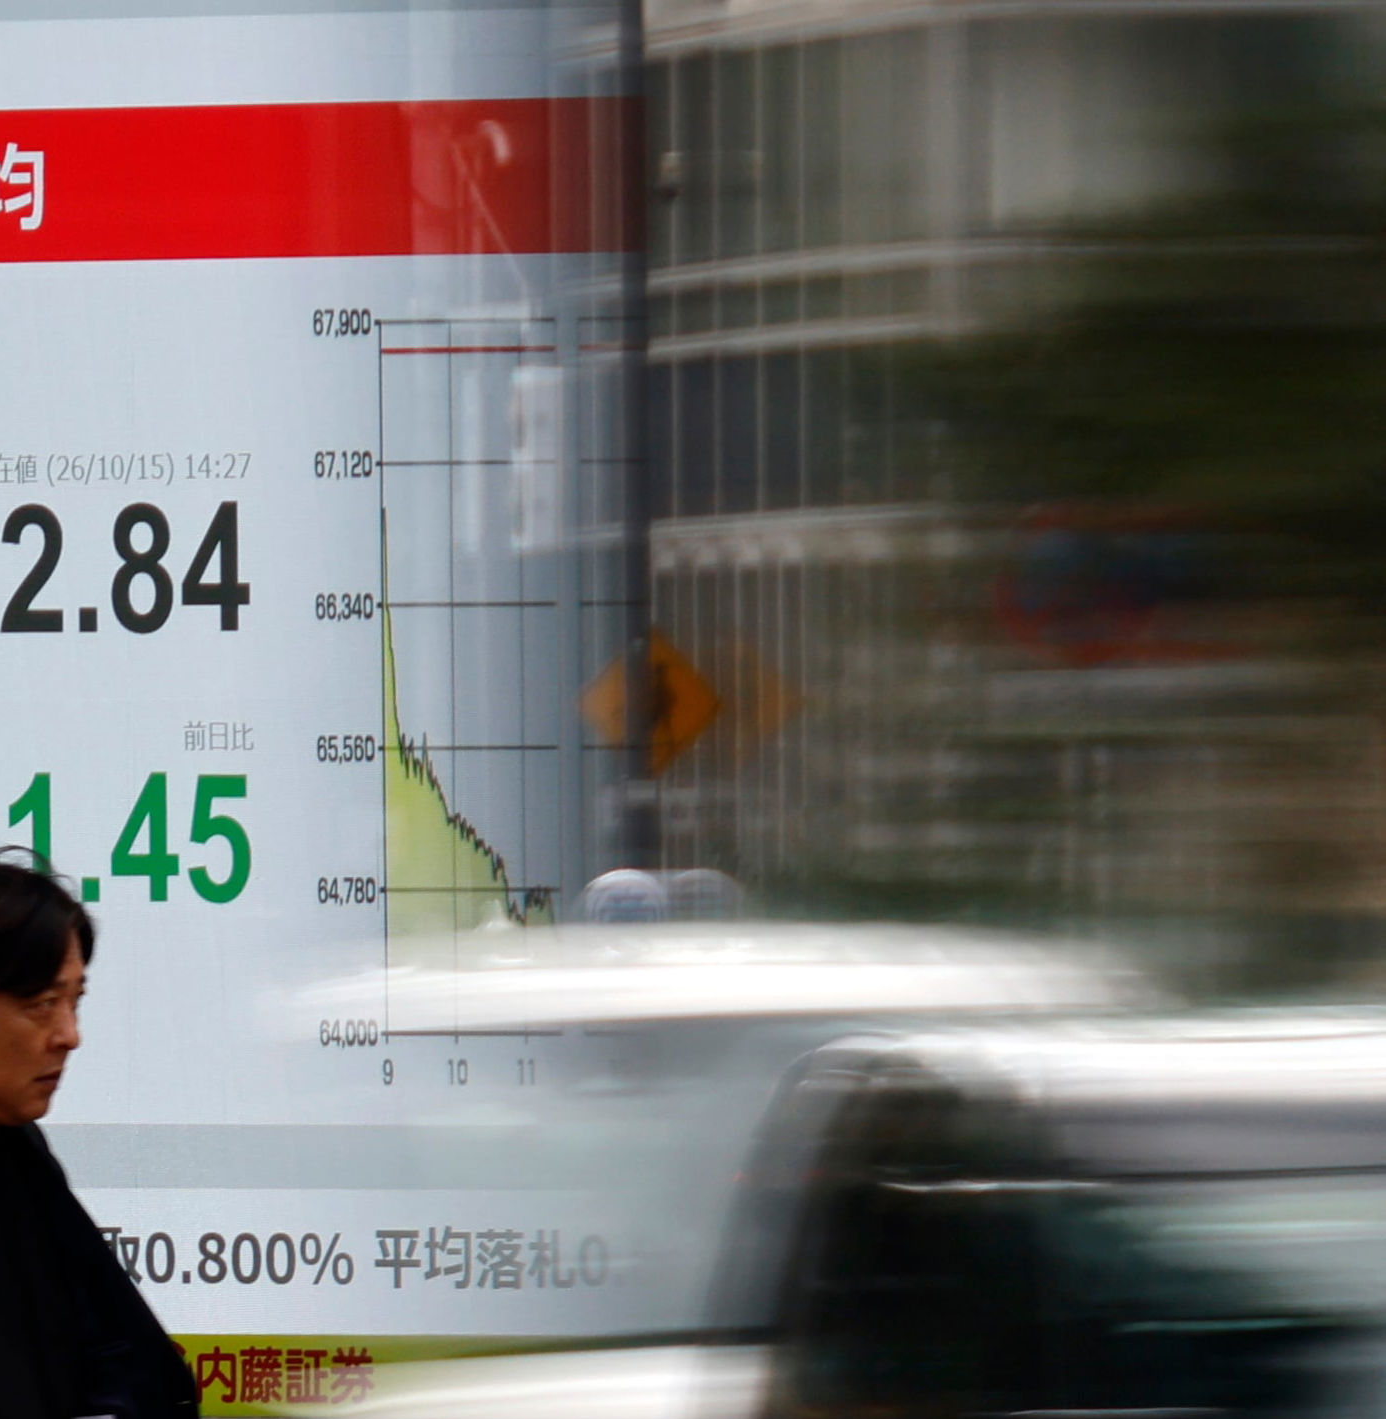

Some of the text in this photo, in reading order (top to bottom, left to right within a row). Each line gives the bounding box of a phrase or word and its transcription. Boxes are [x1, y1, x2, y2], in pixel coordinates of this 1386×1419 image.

[313, 308, 371, 337] 67,900
[46, 452, 175, 487] (26/10/15)
[186, 452, 252, 480] 14:27
[314, 450, 373, 479] 67,120
[315, 593, 374, 621] 66,340
[183, 720, 254, 752] 前日比
[317, 735, 375, 764] 65,560
[317, 877, 376, 906] 64,780
[319, 1019, 379, 1047] 64,000
[382, 1058, 536, 1086] 9 10 11
[196, 1347, 374, 1404] 内藤証券
